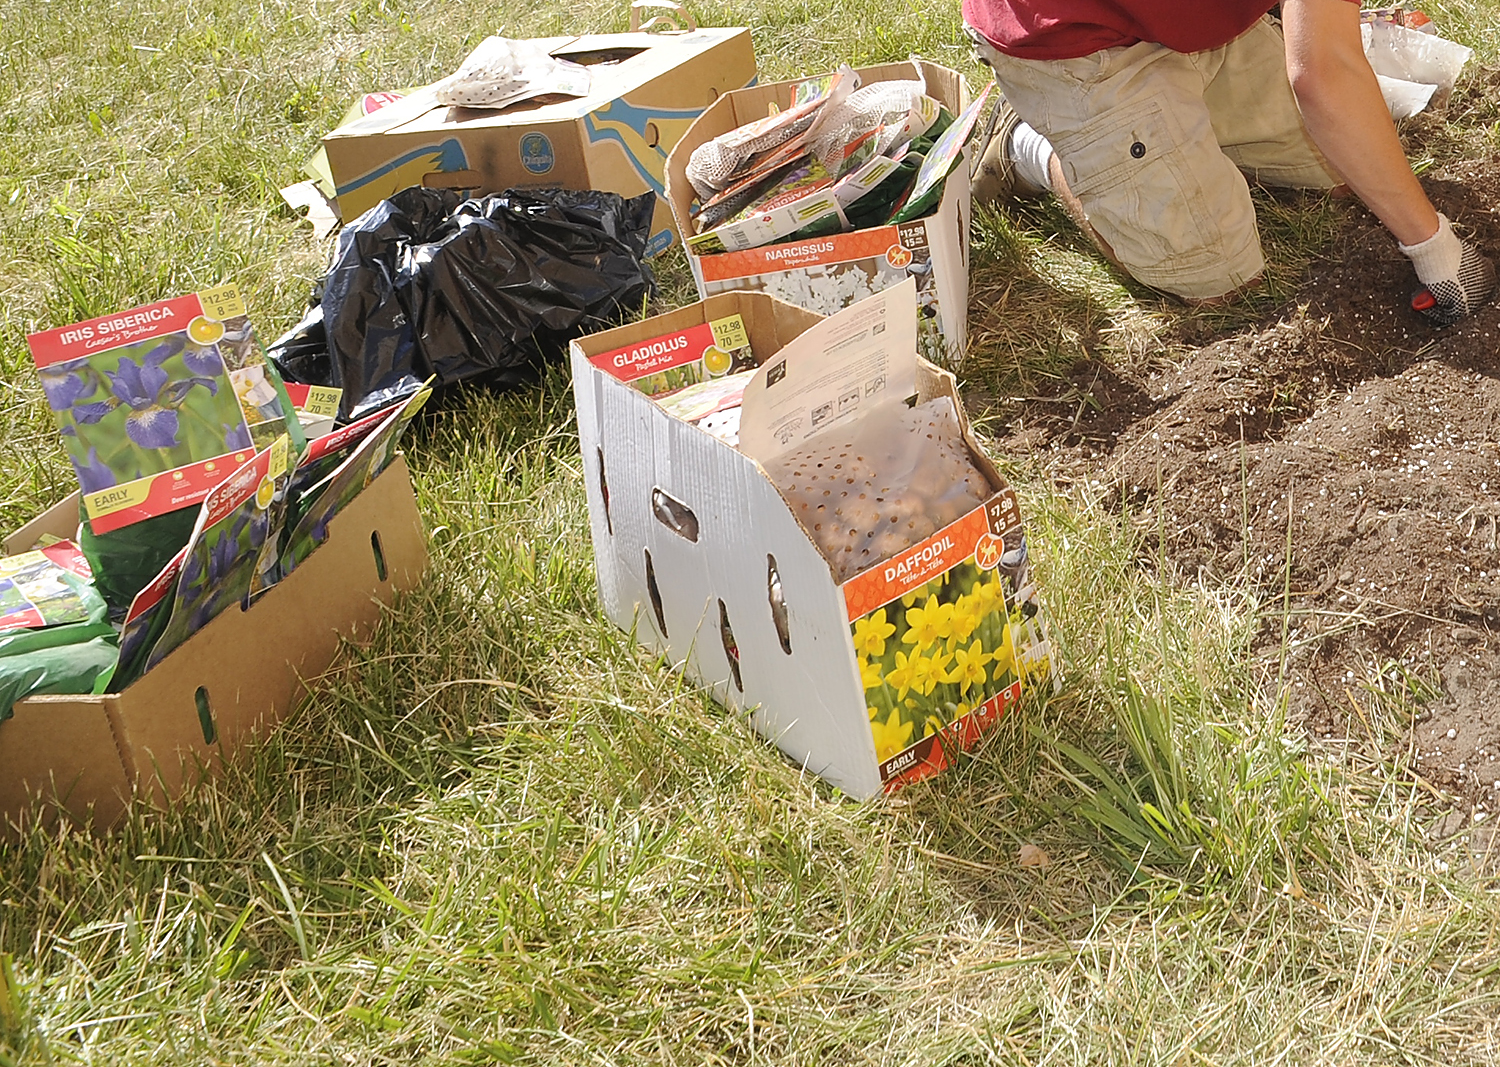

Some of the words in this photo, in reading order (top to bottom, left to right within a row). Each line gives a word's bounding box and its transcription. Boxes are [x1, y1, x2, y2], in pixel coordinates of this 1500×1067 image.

[900, 225, 925, 237] $12.98
[904, 237, 915, 247] 15
[765, 241, 835, 261] NARCISSUS
[203, 289, 236, 305] $12.98
[217, 306, 225, 316] 8
[60, 327, 94, 345] IRIS
[98, 306, 175, 335] SIBERICA
[124, 324, 159, 339] Brother
[714, 321, 741, 335] $12.98
[720, 337, 732, 348] 70
[613, 335, 688, 368] GLADIOLUS
[658, 354, 674, 366] Mix
[311, 391, 337, 404] $12.98
[94, 489, 128, 507] EARLY
[990, 497, 1014, 520] $7.98
[994, 519, 1006, 533] 15
[884, 535, 955, 583] DAFFODIL
[886, 749, 916, 775] EARLY
